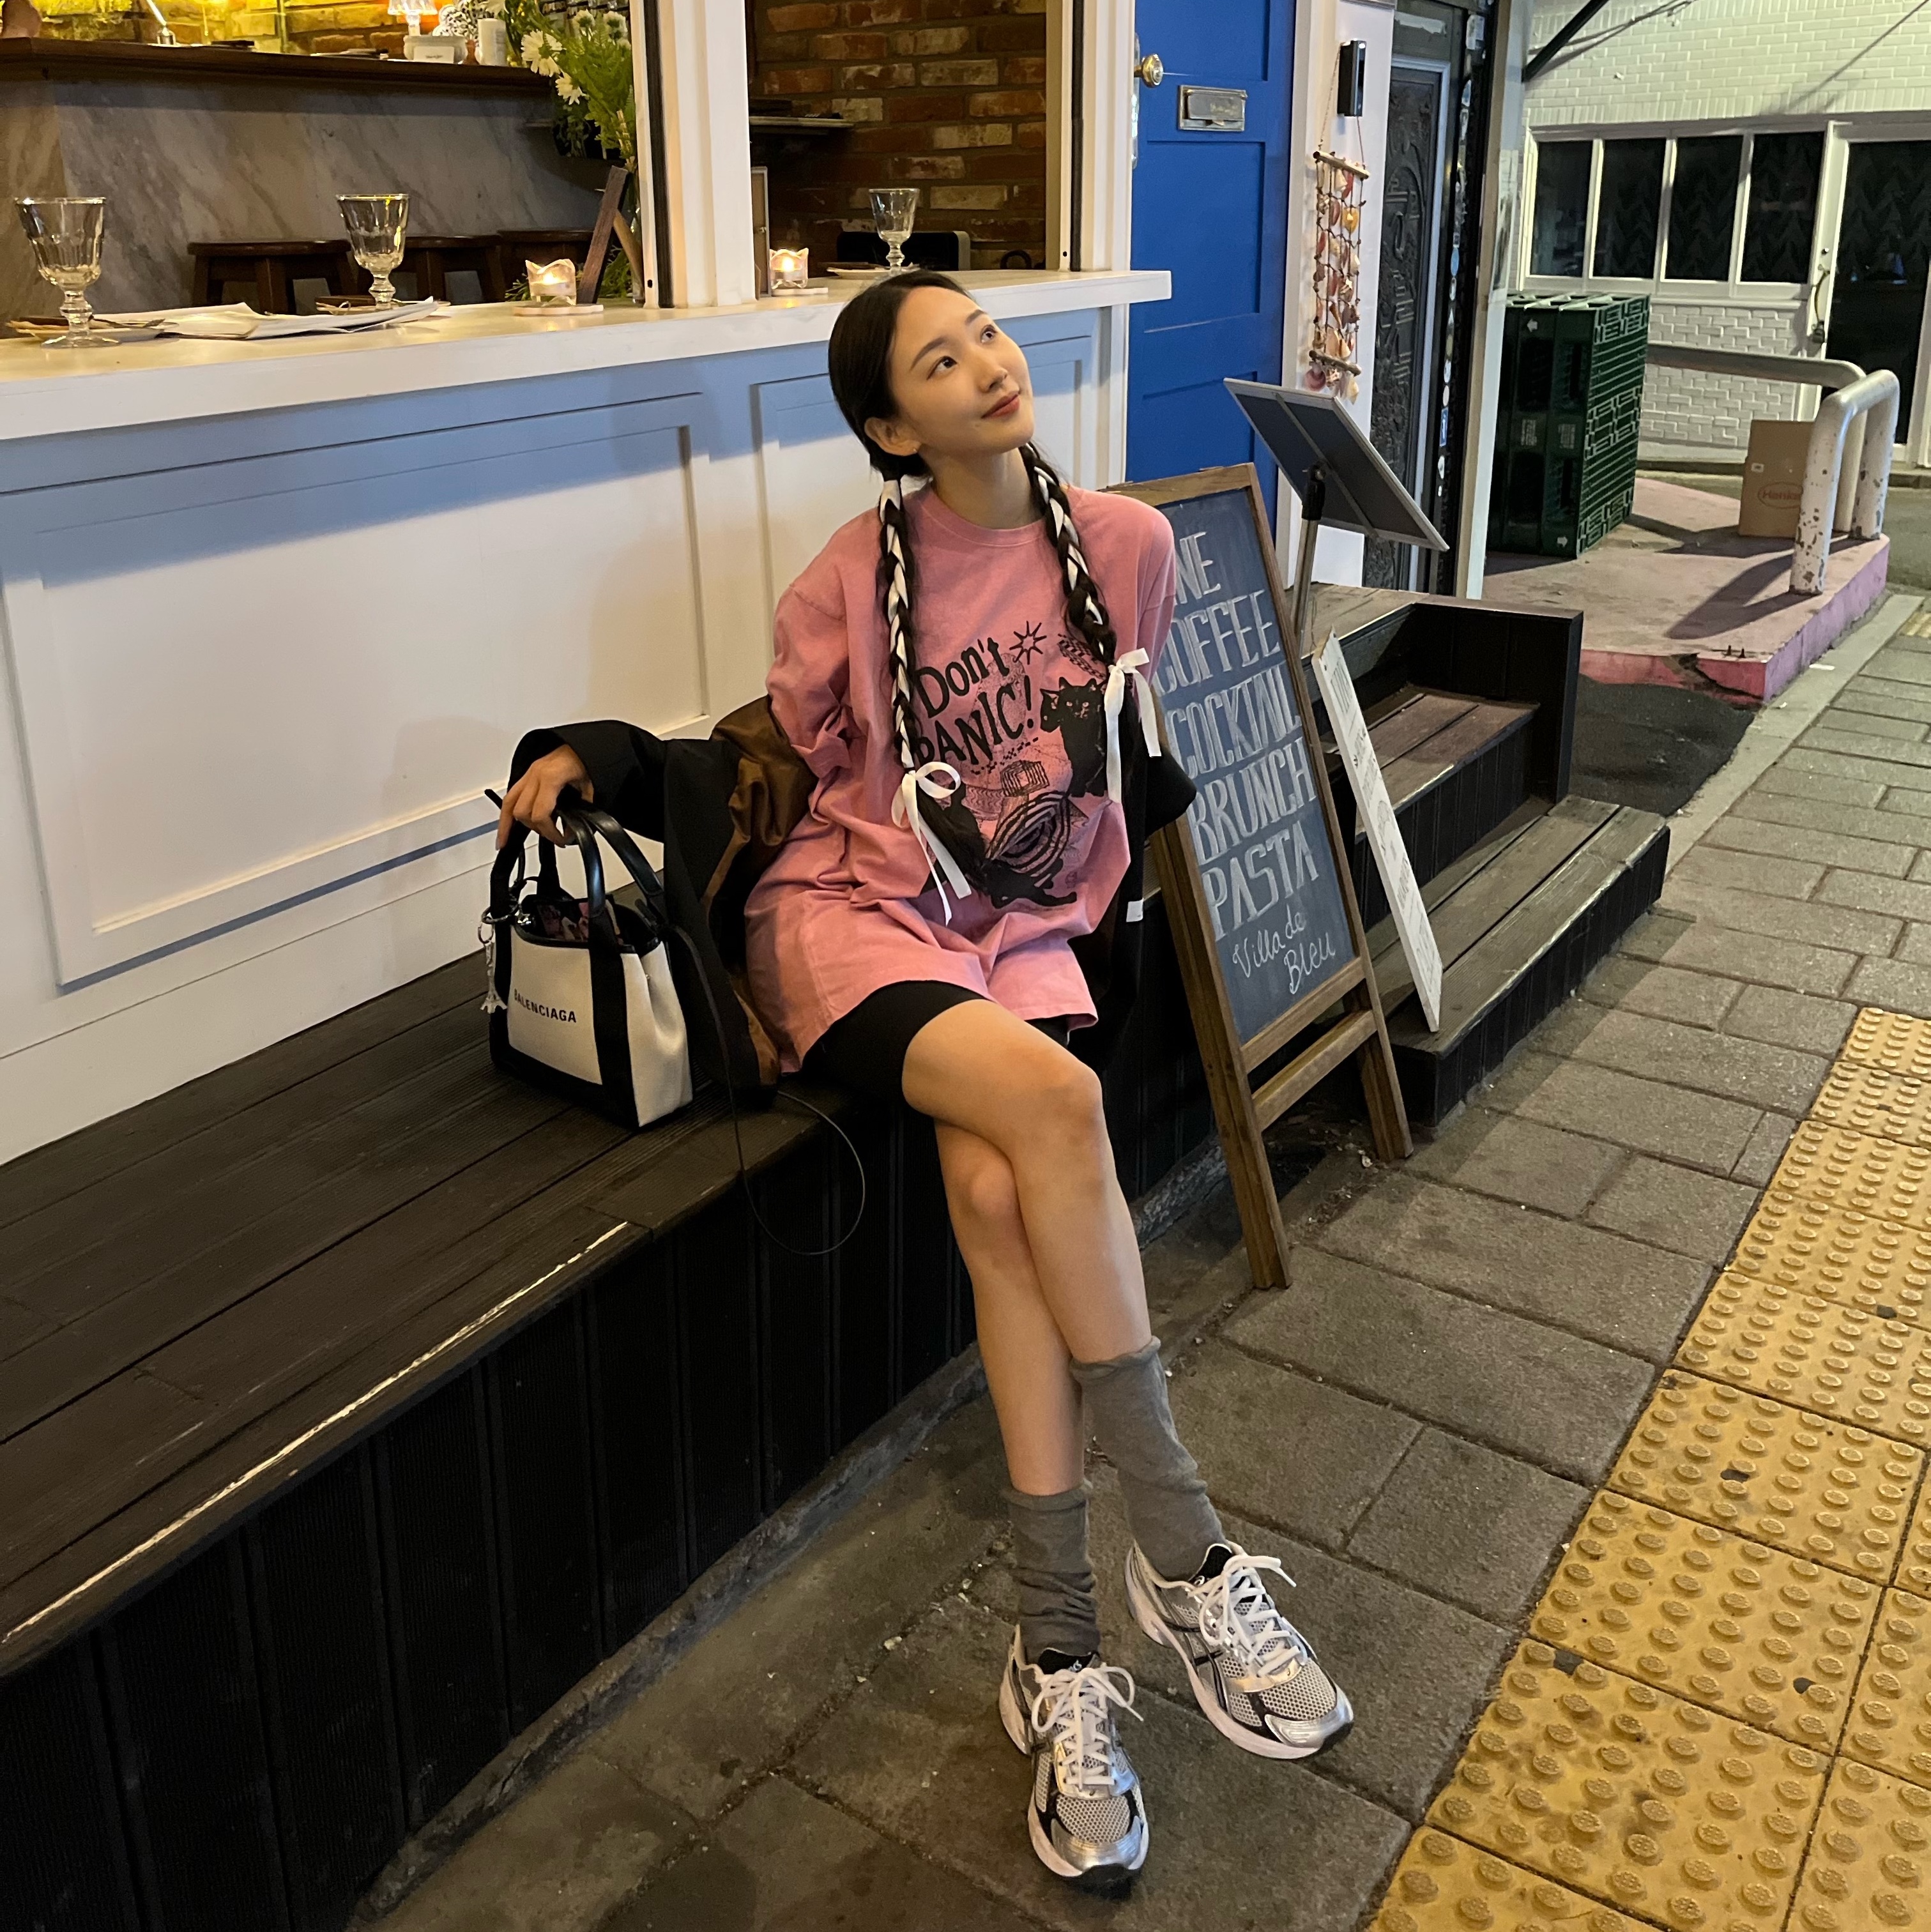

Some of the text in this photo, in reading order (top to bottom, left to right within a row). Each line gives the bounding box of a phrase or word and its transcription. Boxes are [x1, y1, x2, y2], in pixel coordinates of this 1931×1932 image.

[1762, 489, 1801, 499] Henke
[1174, 531, 1221, 605] NE
[915, 637, 1010, 719] Don't
[915, 674, 1034, 766] PANIC!
[1164, 663, 1302, 780] COCKTAIL
[1187, 736, 1317, 866] BRUNCH
[1201, 820, 1319, 942] PASTA
[1232, 903, 1307, 978] Villa de
[1283, 932, 1336, 995] Bleu
[514, 988, 577, 1023] BALENCIAGA
